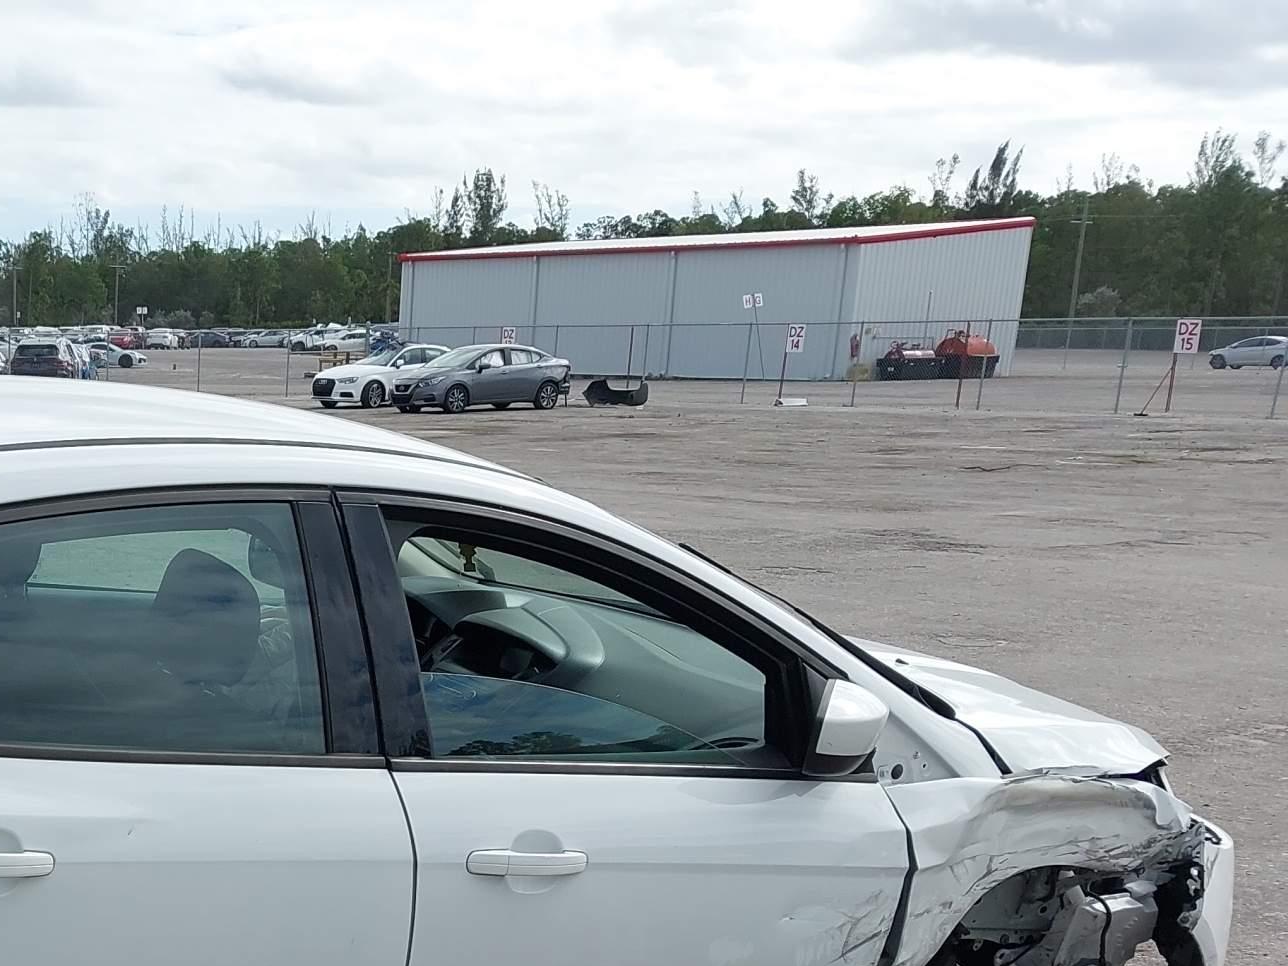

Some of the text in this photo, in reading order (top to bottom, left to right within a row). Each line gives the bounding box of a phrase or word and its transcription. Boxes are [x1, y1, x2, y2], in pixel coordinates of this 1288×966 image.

[503, 329, 514, 340] DZ
[789, 326, 804, 338] DZ
[1178, 322, 1199, 336] DZ
[791, 339, 800, 350] 14
[1181, 338, 1194, 351] 15
